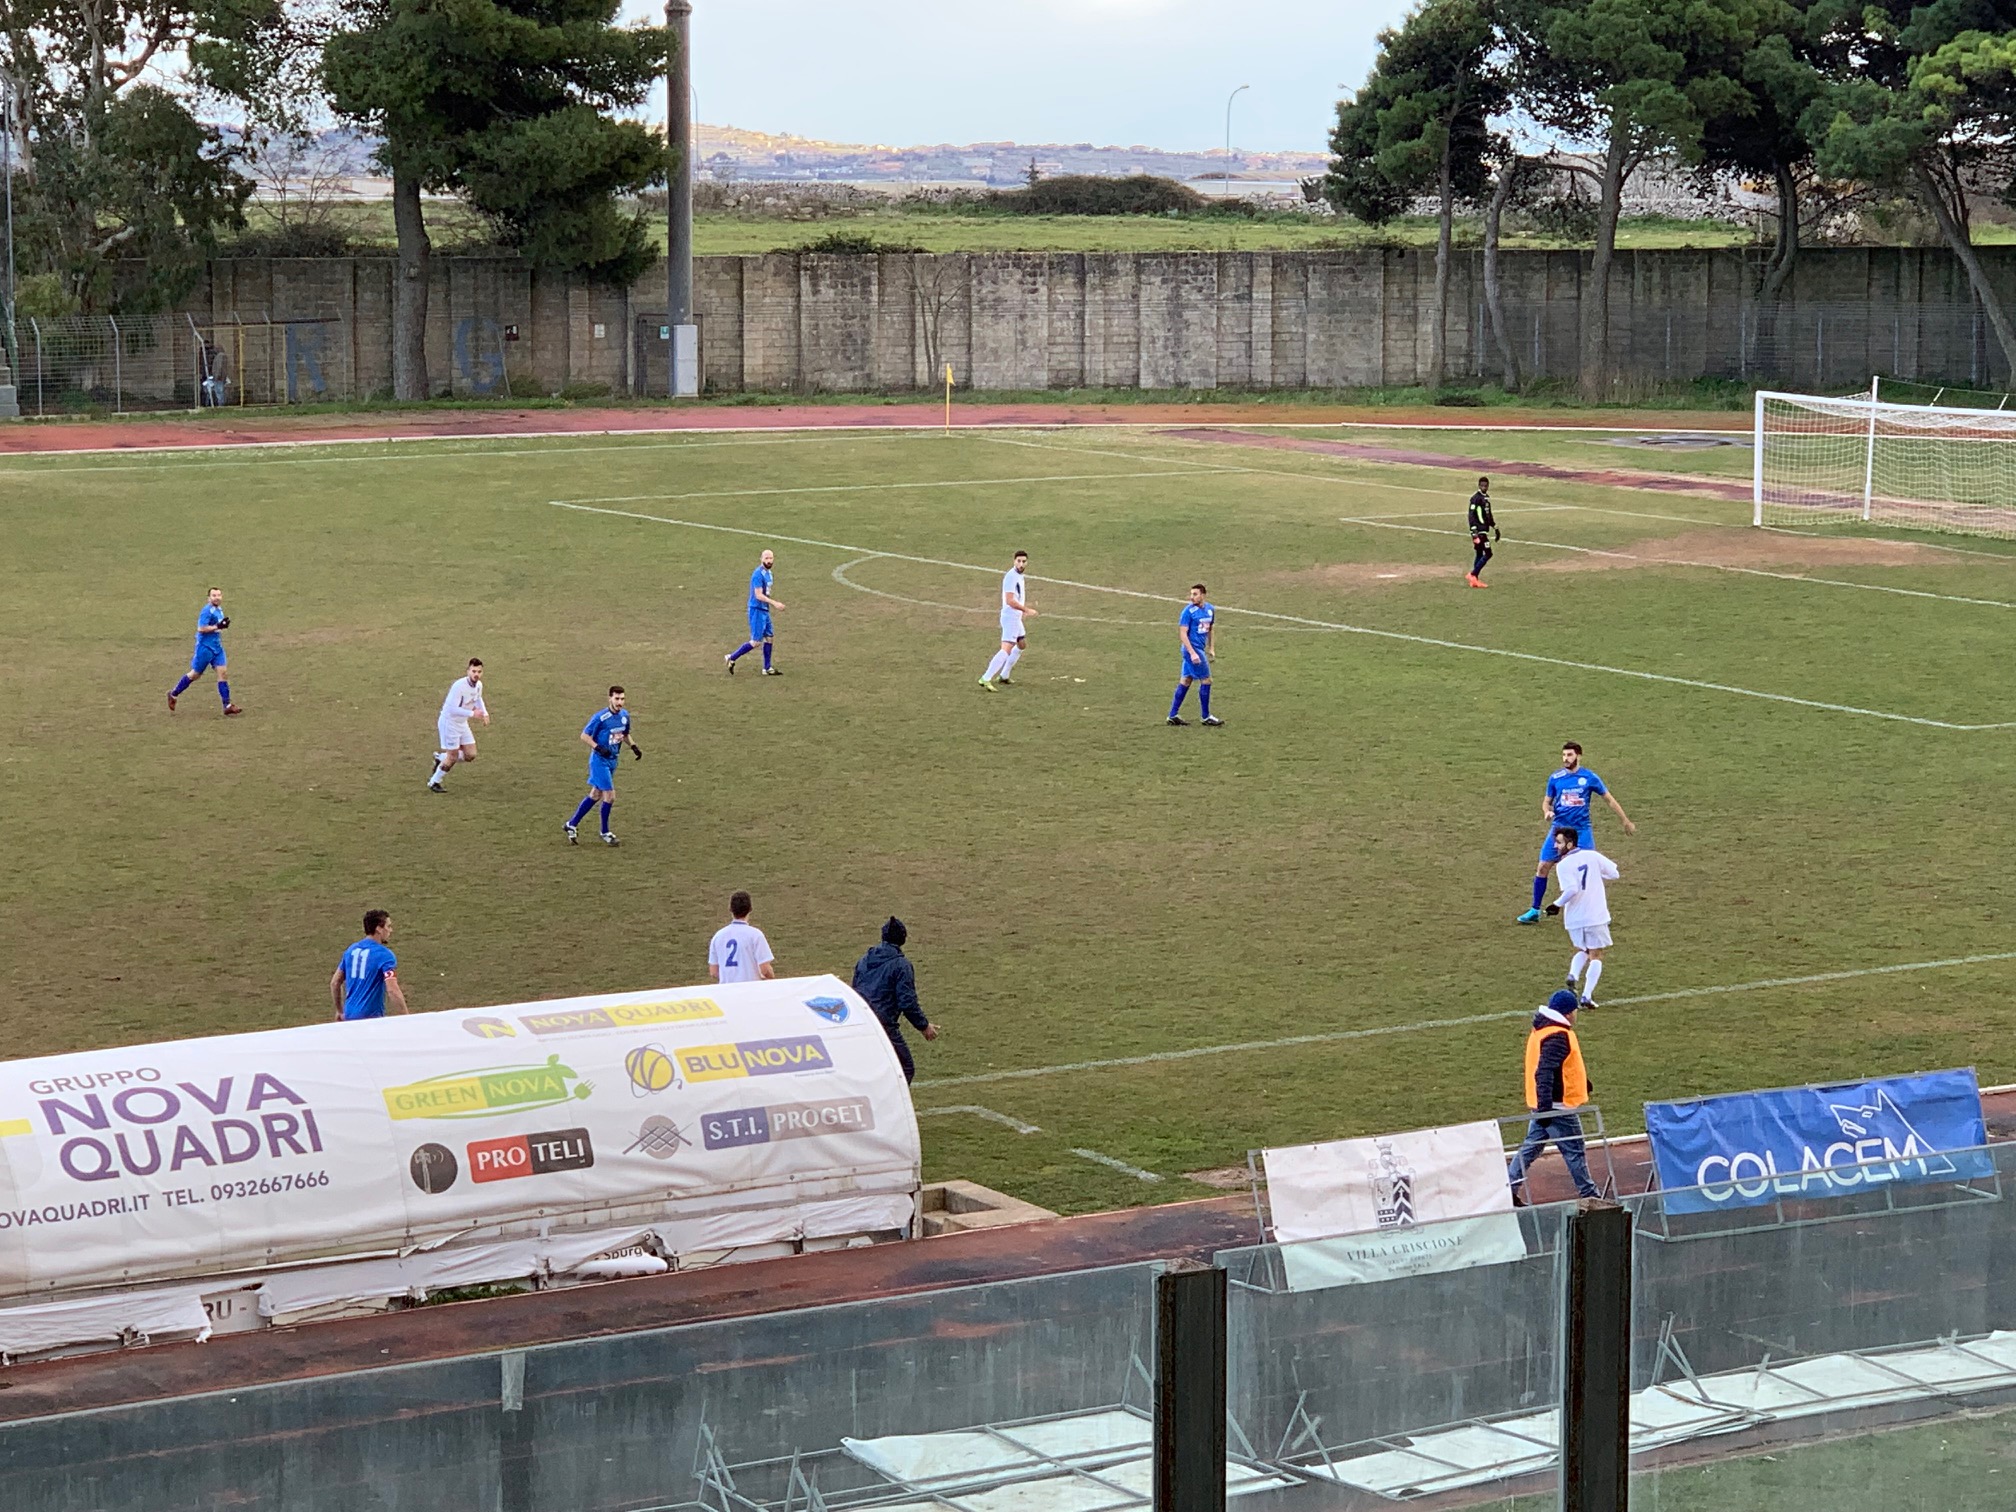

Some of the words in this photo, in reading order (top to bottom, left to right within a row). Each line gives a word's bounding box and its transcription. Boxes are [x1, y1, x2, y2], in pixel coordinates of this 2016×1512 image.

[1577, 864, 1588, 890] 7
[351, 948, 370, 979] 11
[725, 939, 738, 967] 2
[527, 1008, 607, 1029] NOVA
[614, 1001, 714, 1021] QUADRI
[685, 1052, 741, 1074] BLU
[744, 1044, 825, 1069] NOVA
[29, 1067, 162, 1095] GRUPPO
[395, 1085, 478, 1110] GREEN
[484, 1076, 560, 1098] NOVA
[38, 1072, 309, 1135] NOVA
[708, 1117, 763, 1141] S.T.I.
[773, 1104, 864, 1132] PROGET
[60, 1108, 324, 1182] QUADRI
[477, 1146, 527, 1171] PRO
[1697, 1133, 1928, 1202] COLACEM
[162, 1189, 205, 1207] TEL.
[210, 1170, 330, 1201] 0932667666
[1346, 1248, 1388, 1261] VILLA
[1392, 1235, 1463, 1255] CRISCIONE
